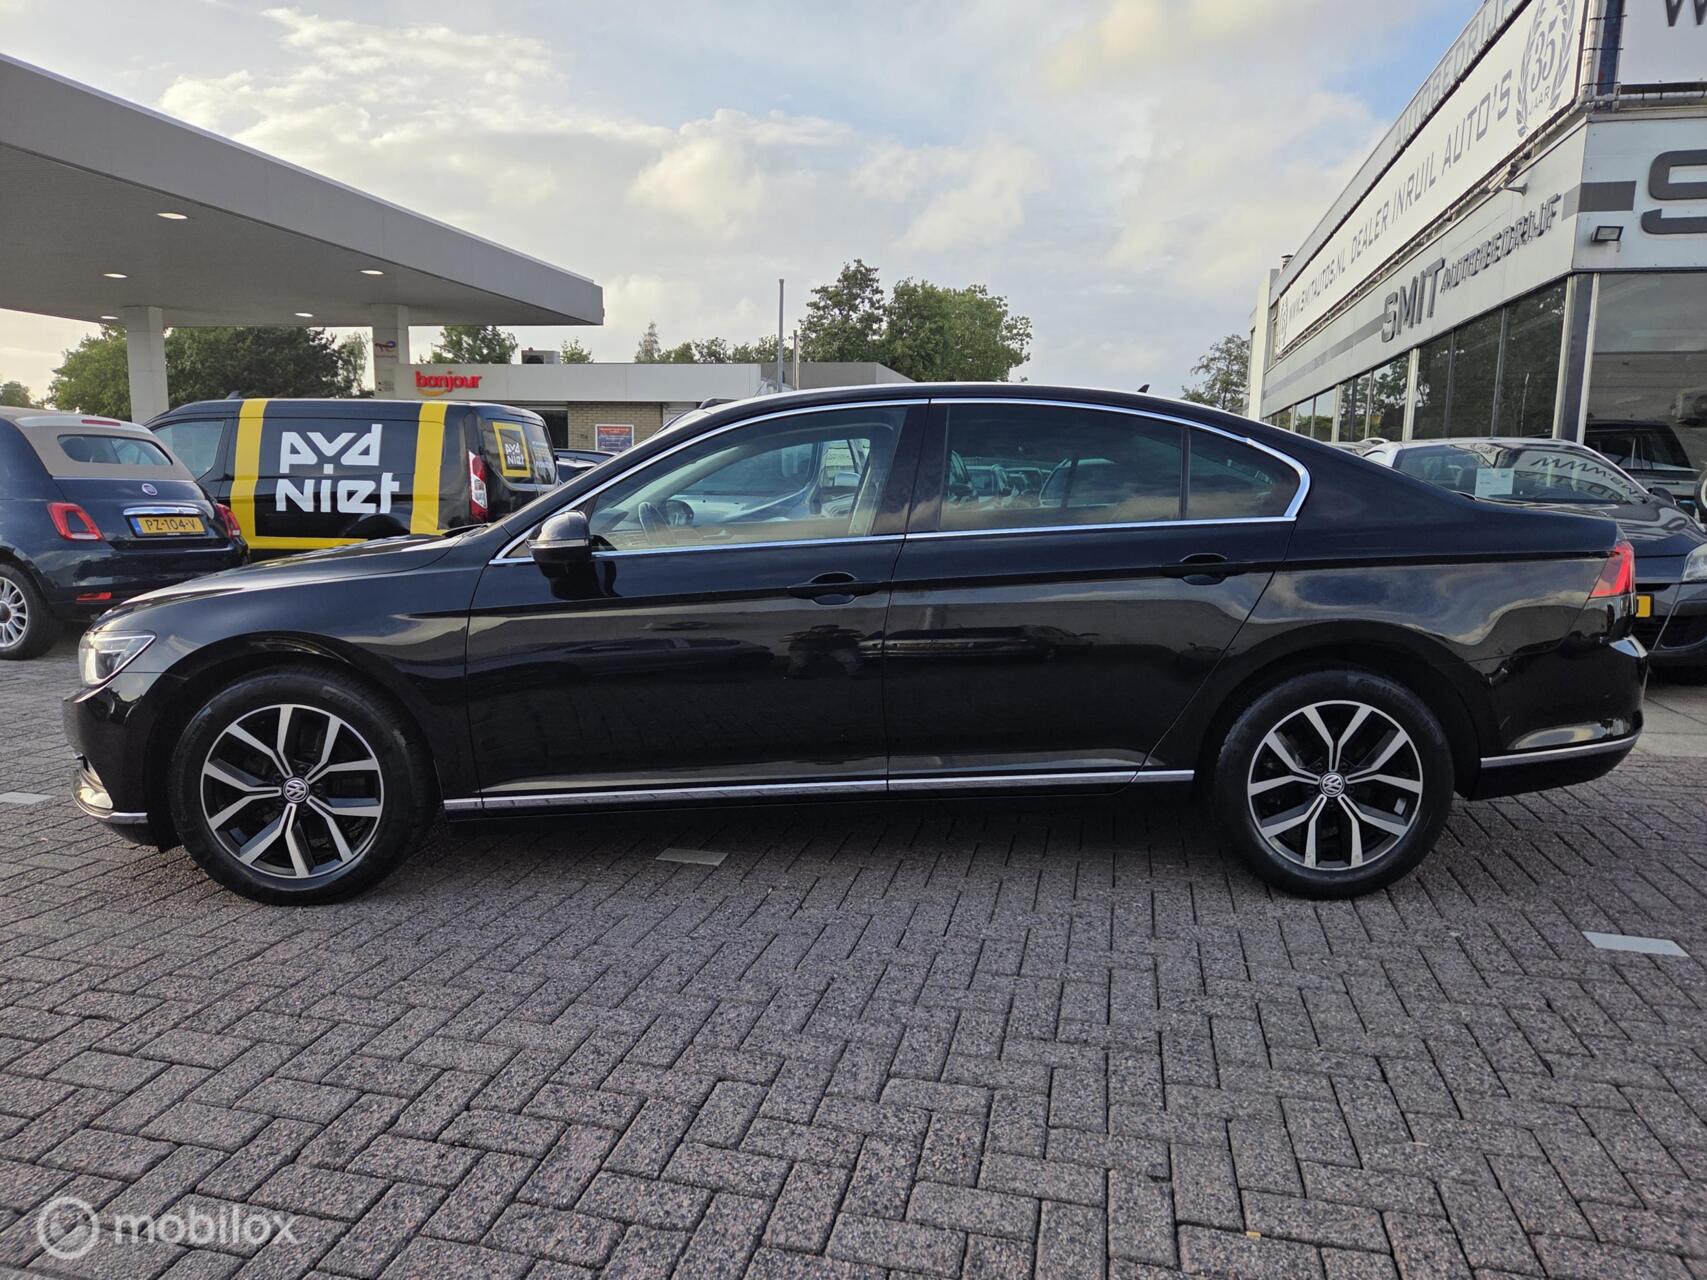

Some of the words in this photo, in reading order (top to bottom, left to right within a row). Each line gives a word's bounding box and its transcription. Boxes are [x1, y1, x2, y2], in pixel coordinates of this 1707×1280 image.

[1531, 17, 1557, 92] 35
[1351, 200, 1389, 264] DEALER
[1392, 152, 1436, 224] INRUIL
[1441, 69, 1512, 176] AUTO'S
[1381, 256, 1446, 342] SMIT
[1440, 193, 1562, 294] AUTOBEDRIJF
[414, 370, 482, 393] bonjour
[145, 519, 196, 531] PZ-104-V
